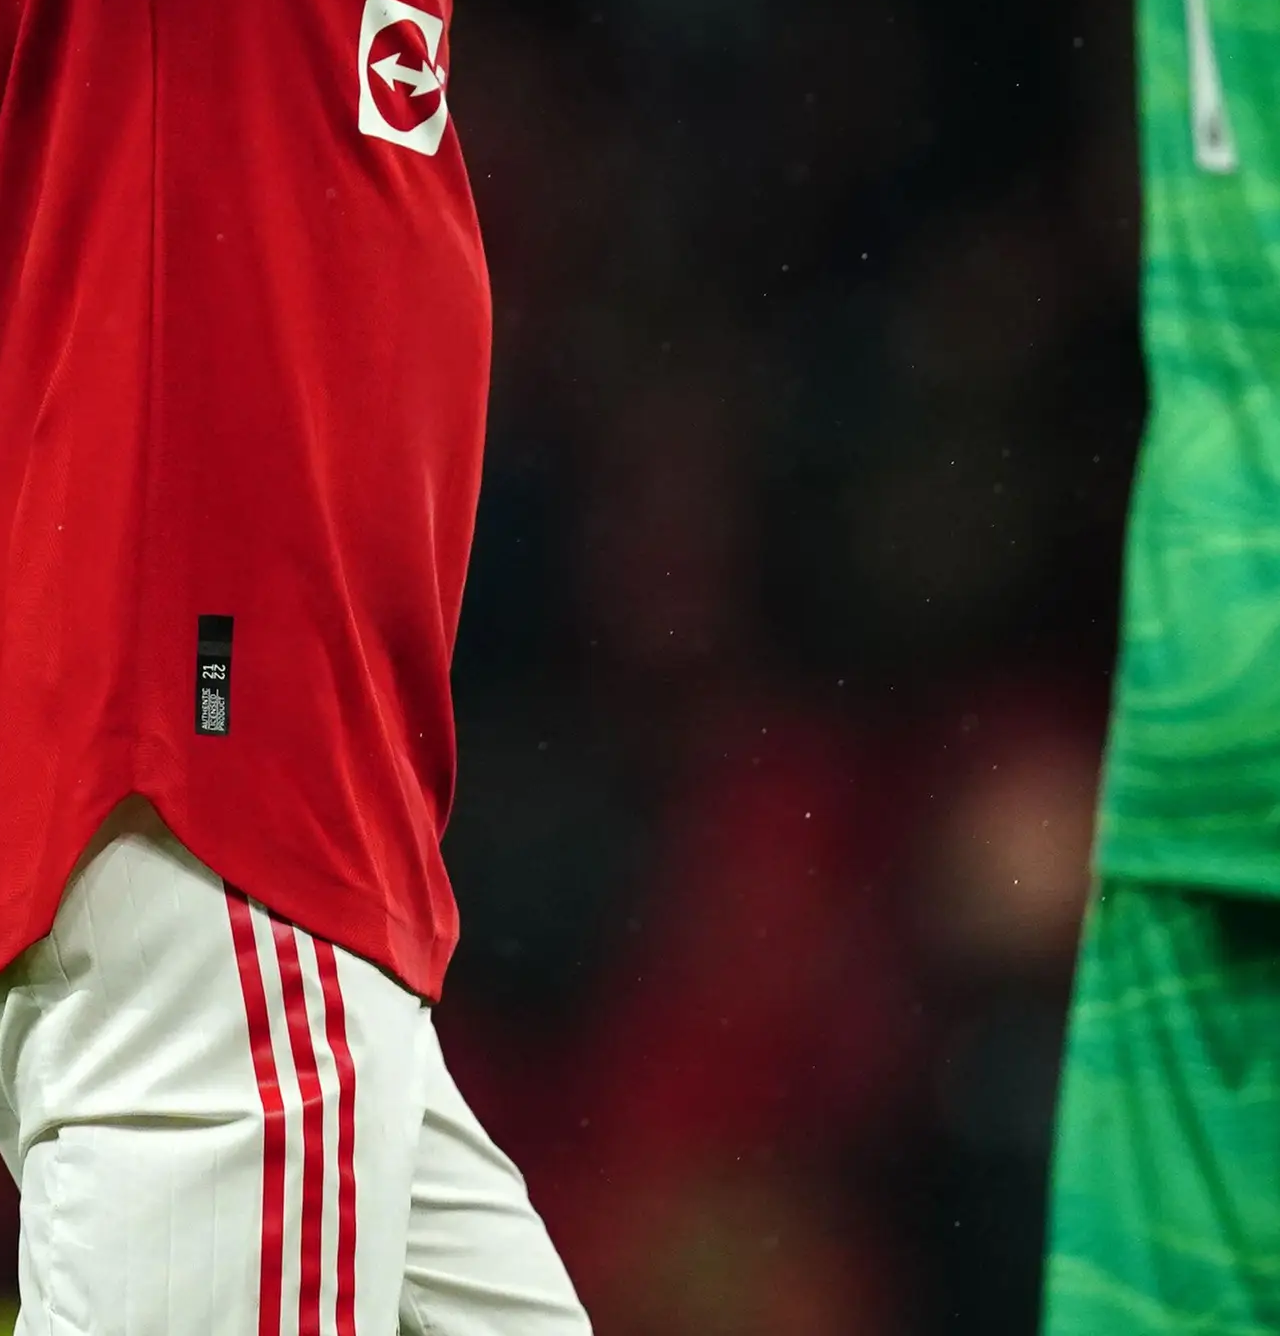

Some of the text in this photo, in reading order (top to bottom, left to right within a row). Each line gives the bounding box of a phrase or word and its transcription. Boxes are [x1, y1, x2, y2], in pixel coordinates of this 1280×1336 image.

[202, 664, 214, 679] 21
[214, 664, 226, 680] 22
[201, 687, 209, 730] AUTHENTIC
